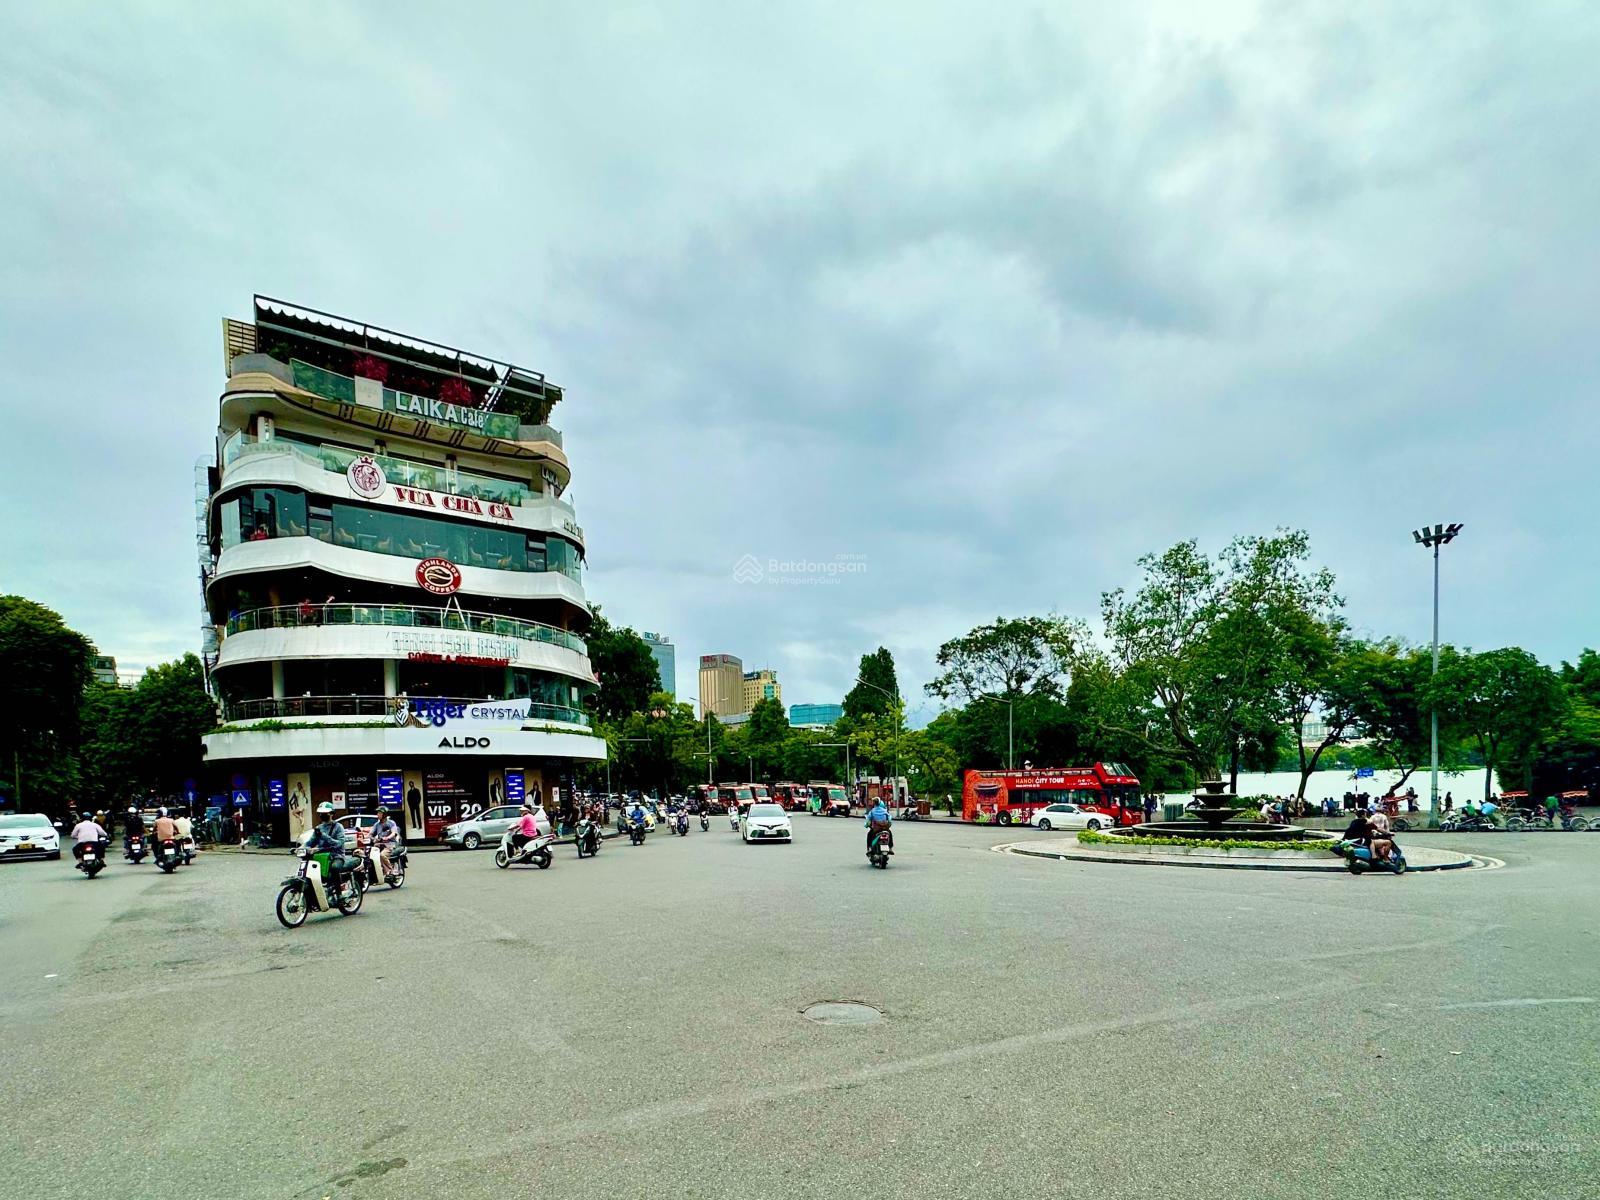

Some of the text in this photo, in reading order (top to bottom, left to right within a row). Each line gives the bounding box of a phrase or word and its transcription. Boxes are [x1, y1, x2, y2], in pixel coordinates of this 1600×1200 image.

[395, 391, 457, 422] LAIKA
[394, 486, 435, 507] VUA
[418, 560, 459, 577] HIGHLANDS
[424, 582, 455, 593] COFFEE
[415, 699, 528, 727] Tiger CRYSTAL
[438, 736, 491, 748] ALDO
[1035, 776, 1047, 784] CITY
[428, 805, 452, 817] VIP
